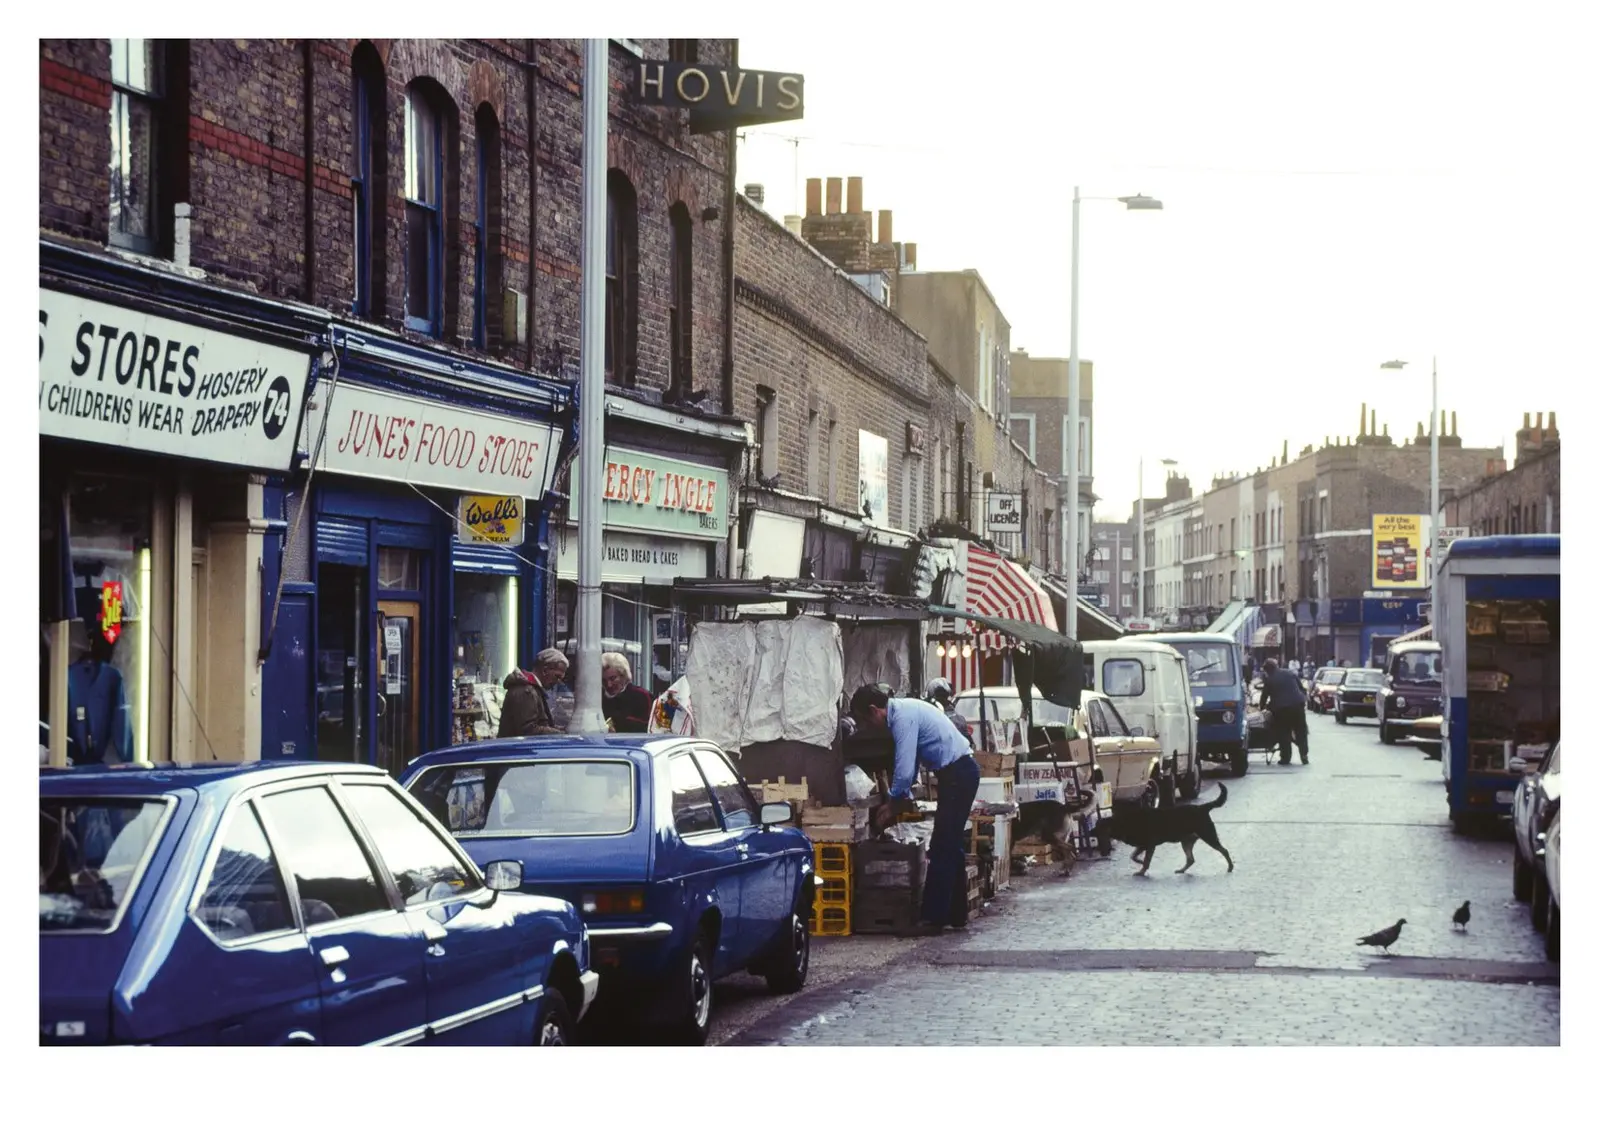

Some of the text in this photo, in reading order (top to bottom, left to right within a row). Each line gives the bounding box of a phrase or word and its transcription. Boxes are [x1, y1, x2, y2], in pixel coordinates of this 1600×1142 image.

[640, 63, 801, 110] HOVIS
[71, 321, 200, 398] STORES
[196, 367, 268, 400] HOSIERY
[48, 383, 133, 425] CHILDRENS
[138, 400, 184, 435] WEAR
[191, 400, 262, 437] DRAPERY
[264, 389, 289, 426] 74
[338, 409, 539, 479] JUNE'S FOOD STORE
[604, 462, 716, 512] ERCY INGLE
[1000, 499, 1013, 510] OFF
[700, 515, 718, 530] BAKERS
[990, 512, 1020, 524] LICENCE
[1379, 524, 1396, 532] very
[1397, 516, 1410, 524] the
[608, 547, 628, 561] BAKED
[632, 549, 651, 563] BREAD
[660, 552, 679, 565] CAKES
[1024, 768, 1074, 779] NEW ZEAAND
[1035, 788, 1056, 800] Jaffa
